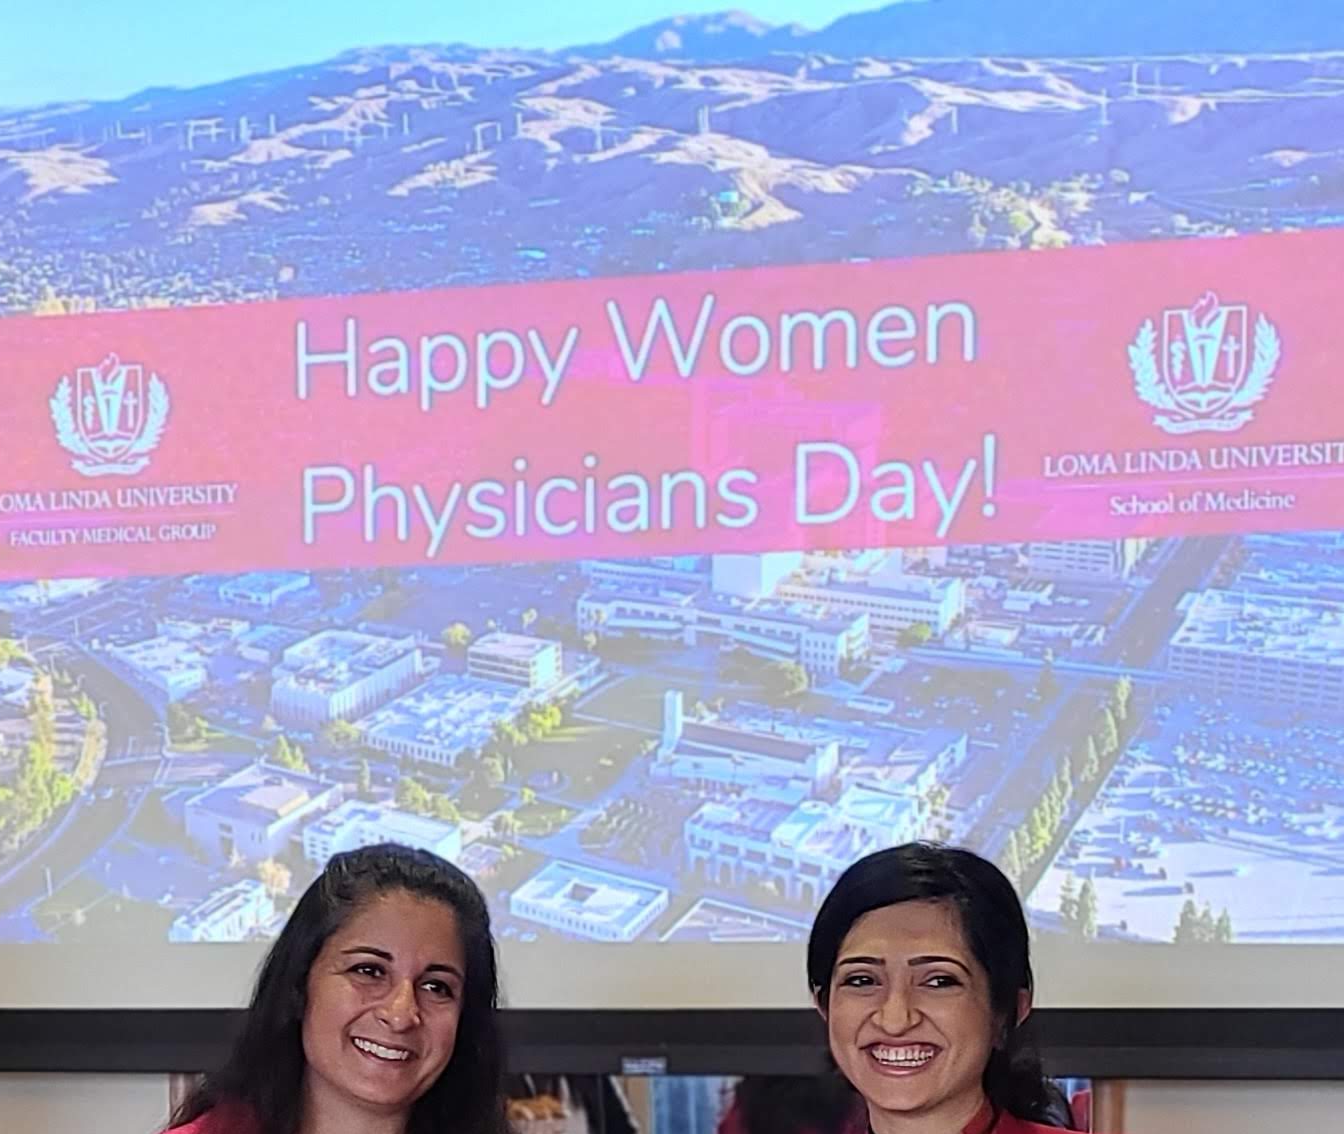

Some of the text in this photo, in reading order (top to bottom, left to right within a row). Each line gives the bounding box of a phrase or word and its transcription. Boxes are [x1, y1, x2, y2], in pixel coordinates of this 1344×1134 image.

[296, 293, 978, 412] Happy Women
[1043, 453, 1118, 478] LOMA
[1123, 448, 1202, 474] LINDA
[50, 489, 112, 512] LINDA
[116, 483, 239, 508] UNIVERSITY
[301, 432, 998, 559] Physicians Day!
[1109, 489, 1297, 516] School of Medicine
[10, 522, 218, 547] FACULTY MEDICAL GROUP
